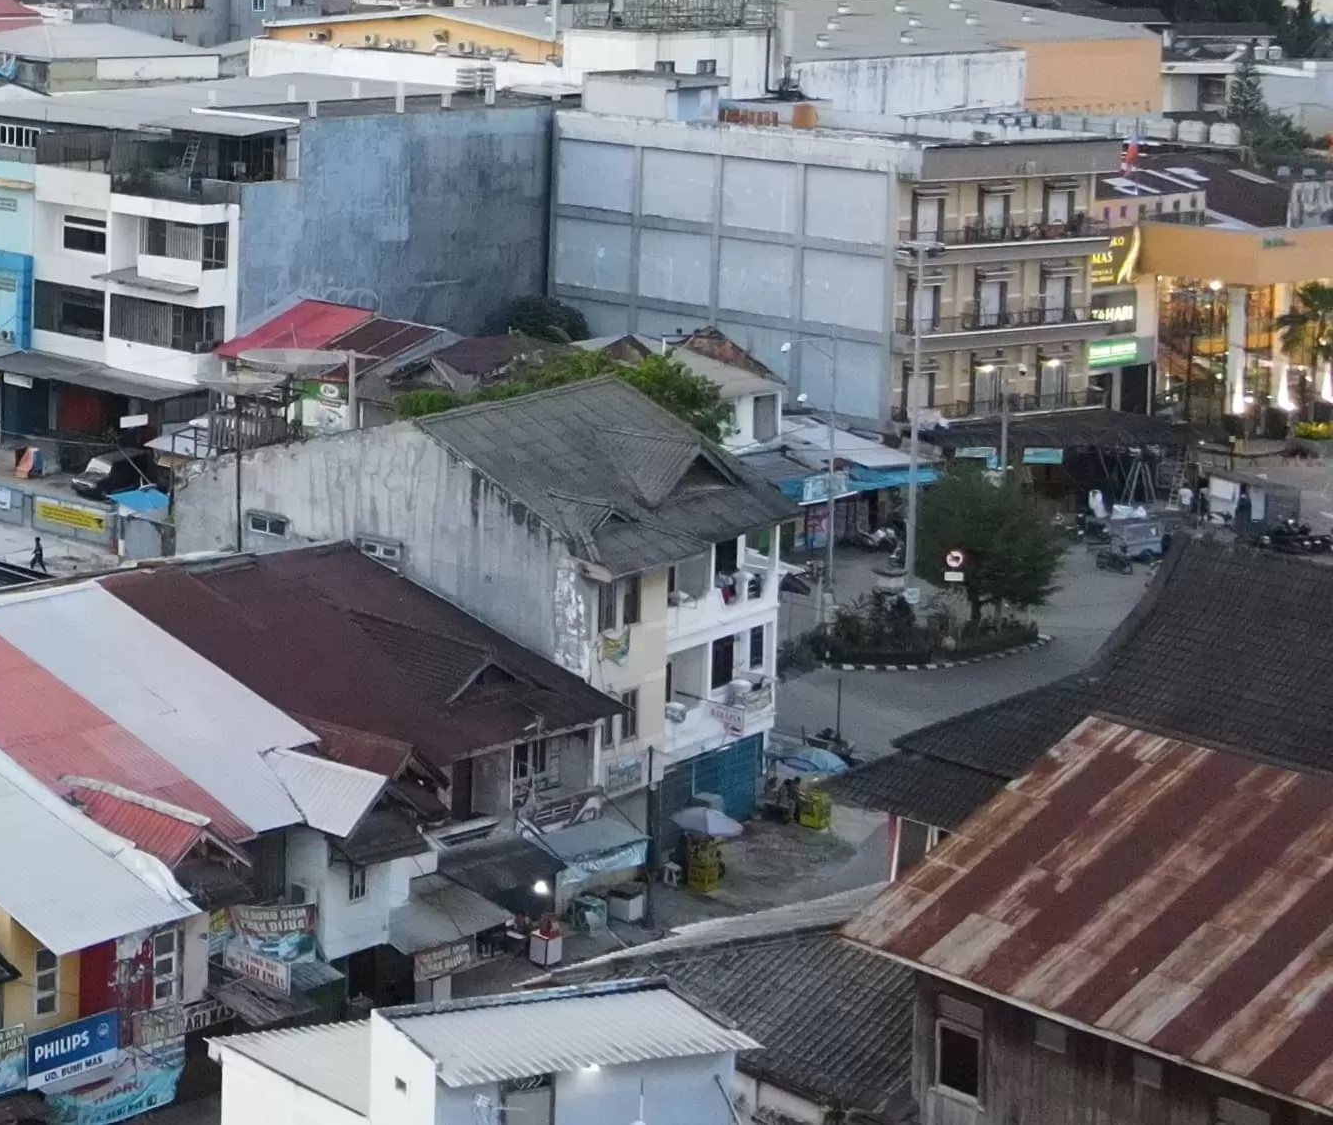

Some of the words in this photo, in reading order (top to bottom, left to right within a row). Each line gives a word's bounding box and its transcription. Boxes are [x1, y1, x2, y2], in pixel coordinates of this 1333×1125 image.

[1091, 305, 1134, 321] TAHARI
[34, 1029, 90, 1063] PHILIPS
[61, 1063, 83, 1078] BUMI
[85, 1055, 104, 1069] MAS
